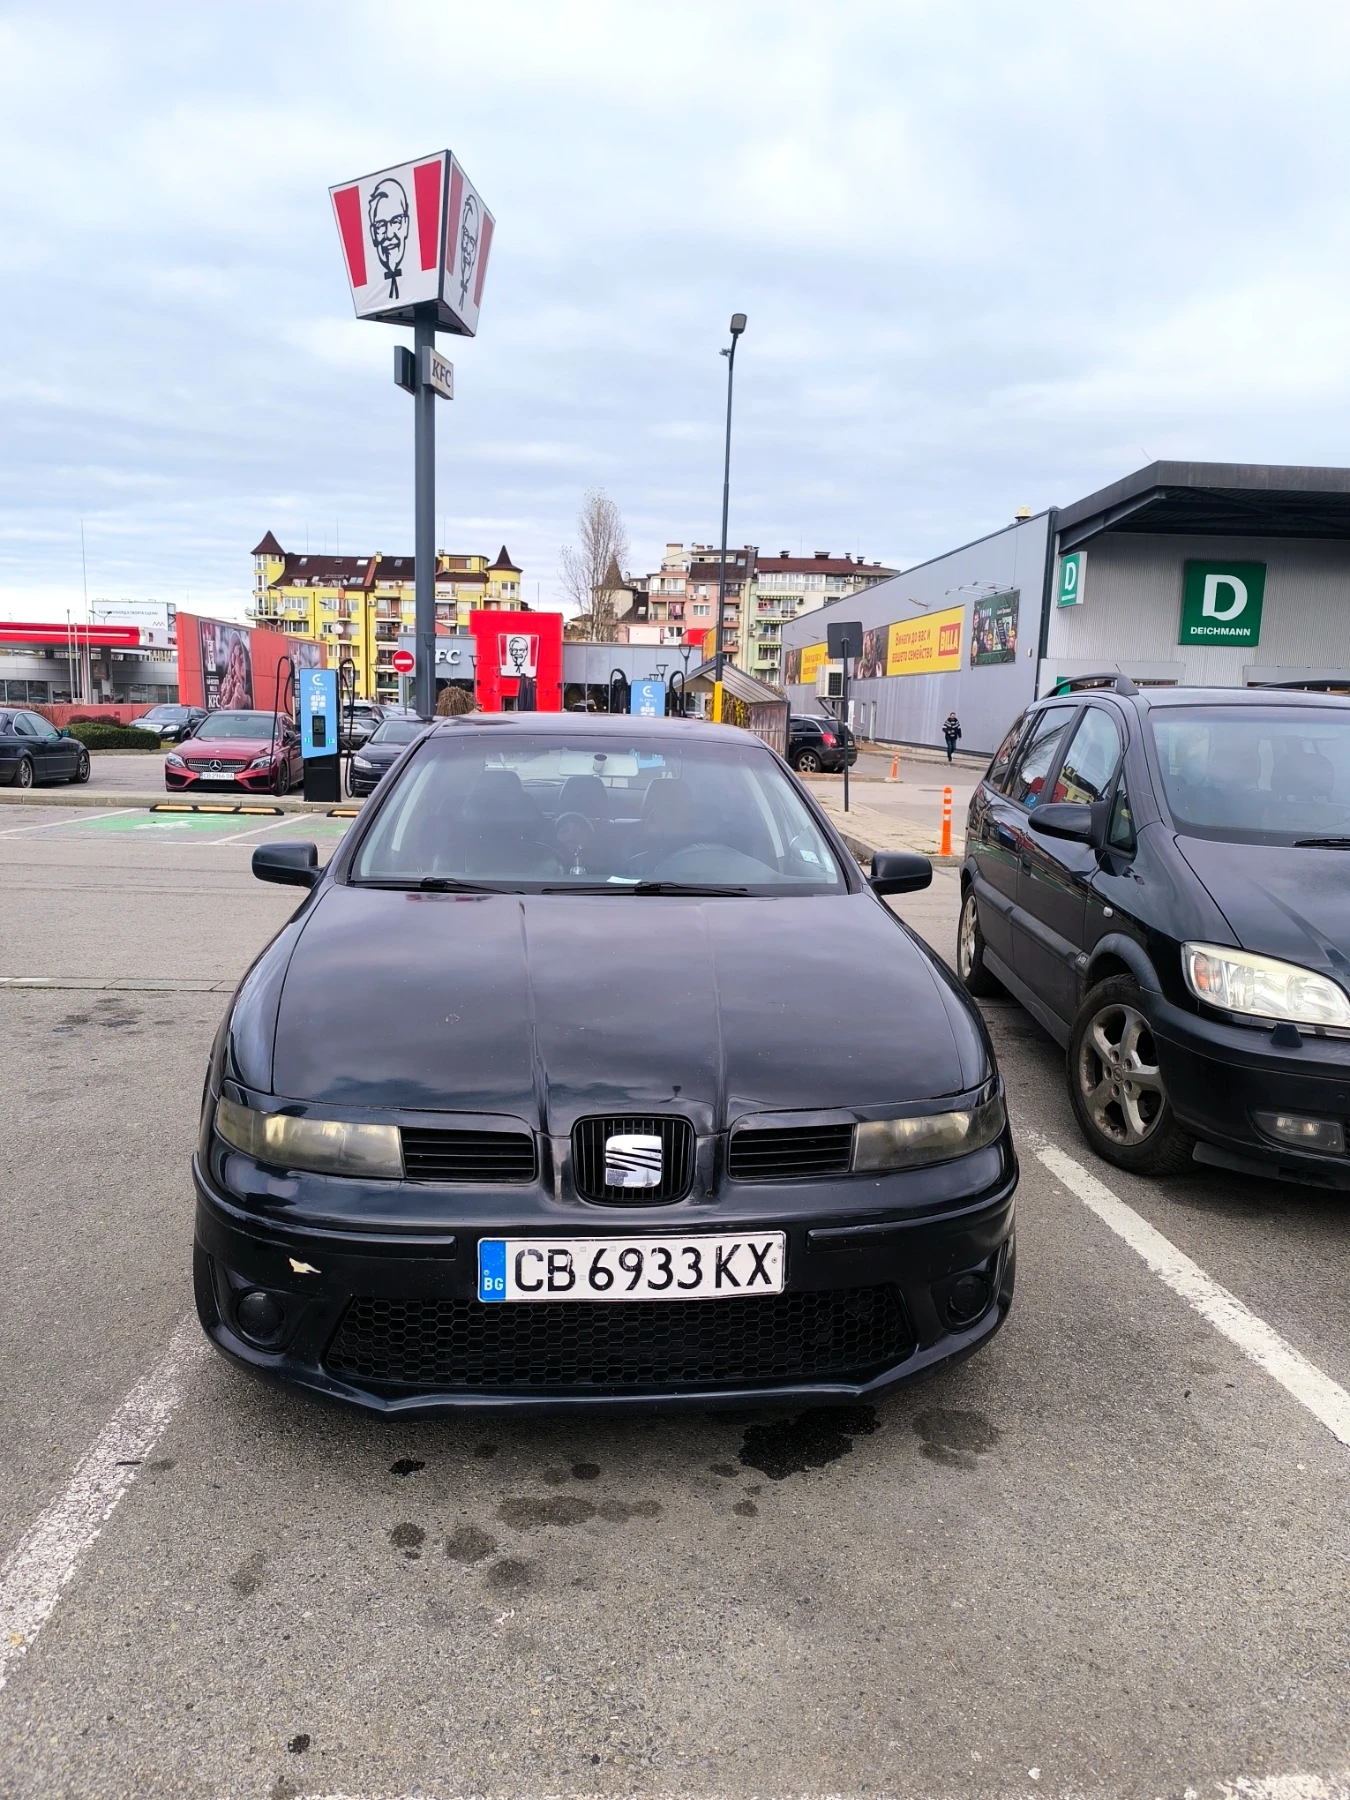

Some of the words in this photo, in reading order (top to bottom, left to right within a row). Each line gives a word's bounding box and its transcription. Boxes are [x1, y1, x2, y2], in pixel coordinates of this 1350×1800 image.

[432, 357, 452, 389] KFC
[1064, 561, 1077, 591] D
[1202, 574, 1248, 621] D
[895, 632, 911, 646] Винаги
[918, 630, 927, 642] вас
[940, 628, 959, 652] BILLA
[1190, 626, 1251, 636] DEICHMANN
[435, 649, 461, 664] FC
[892, 651, 907, 663] вашето
[908, 645, 933, 661] семейство
[208, 694, 221, 708] KFC
[514, 1248, 576, 1292] CB
[588, 1246, 703, 1291] 6933
[714, 1242, 774, 1288] KX
[483, 1277, 504, 1291] BG
